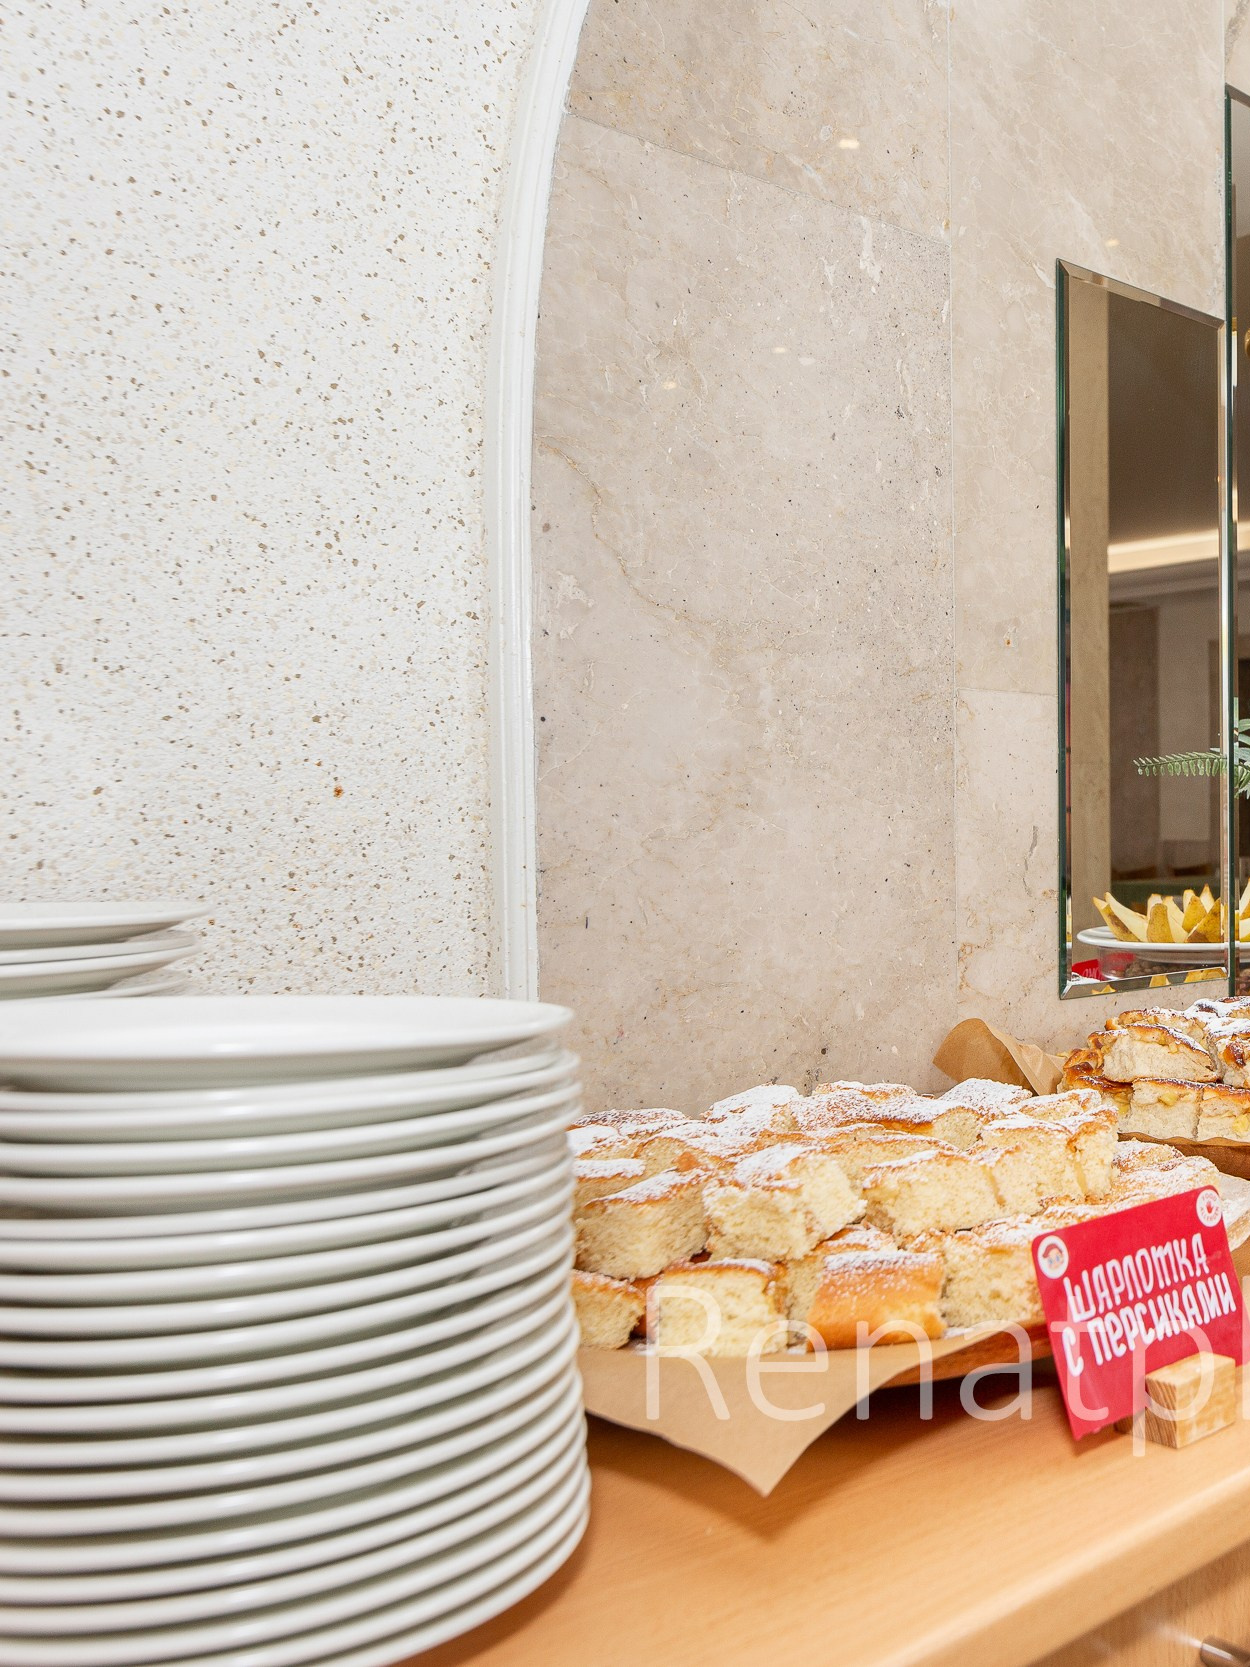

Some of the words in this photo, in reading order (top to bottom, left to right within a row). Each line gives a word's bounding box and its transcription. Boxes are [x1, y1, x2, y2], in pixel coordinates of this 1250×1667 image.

[1062, 1326, 1084, 1377] С
[1087, 1272, 1236, 1366] ПЕРСИКАМИ
[1063, 1233, 1209, 1323] ШАРЛОТКА
